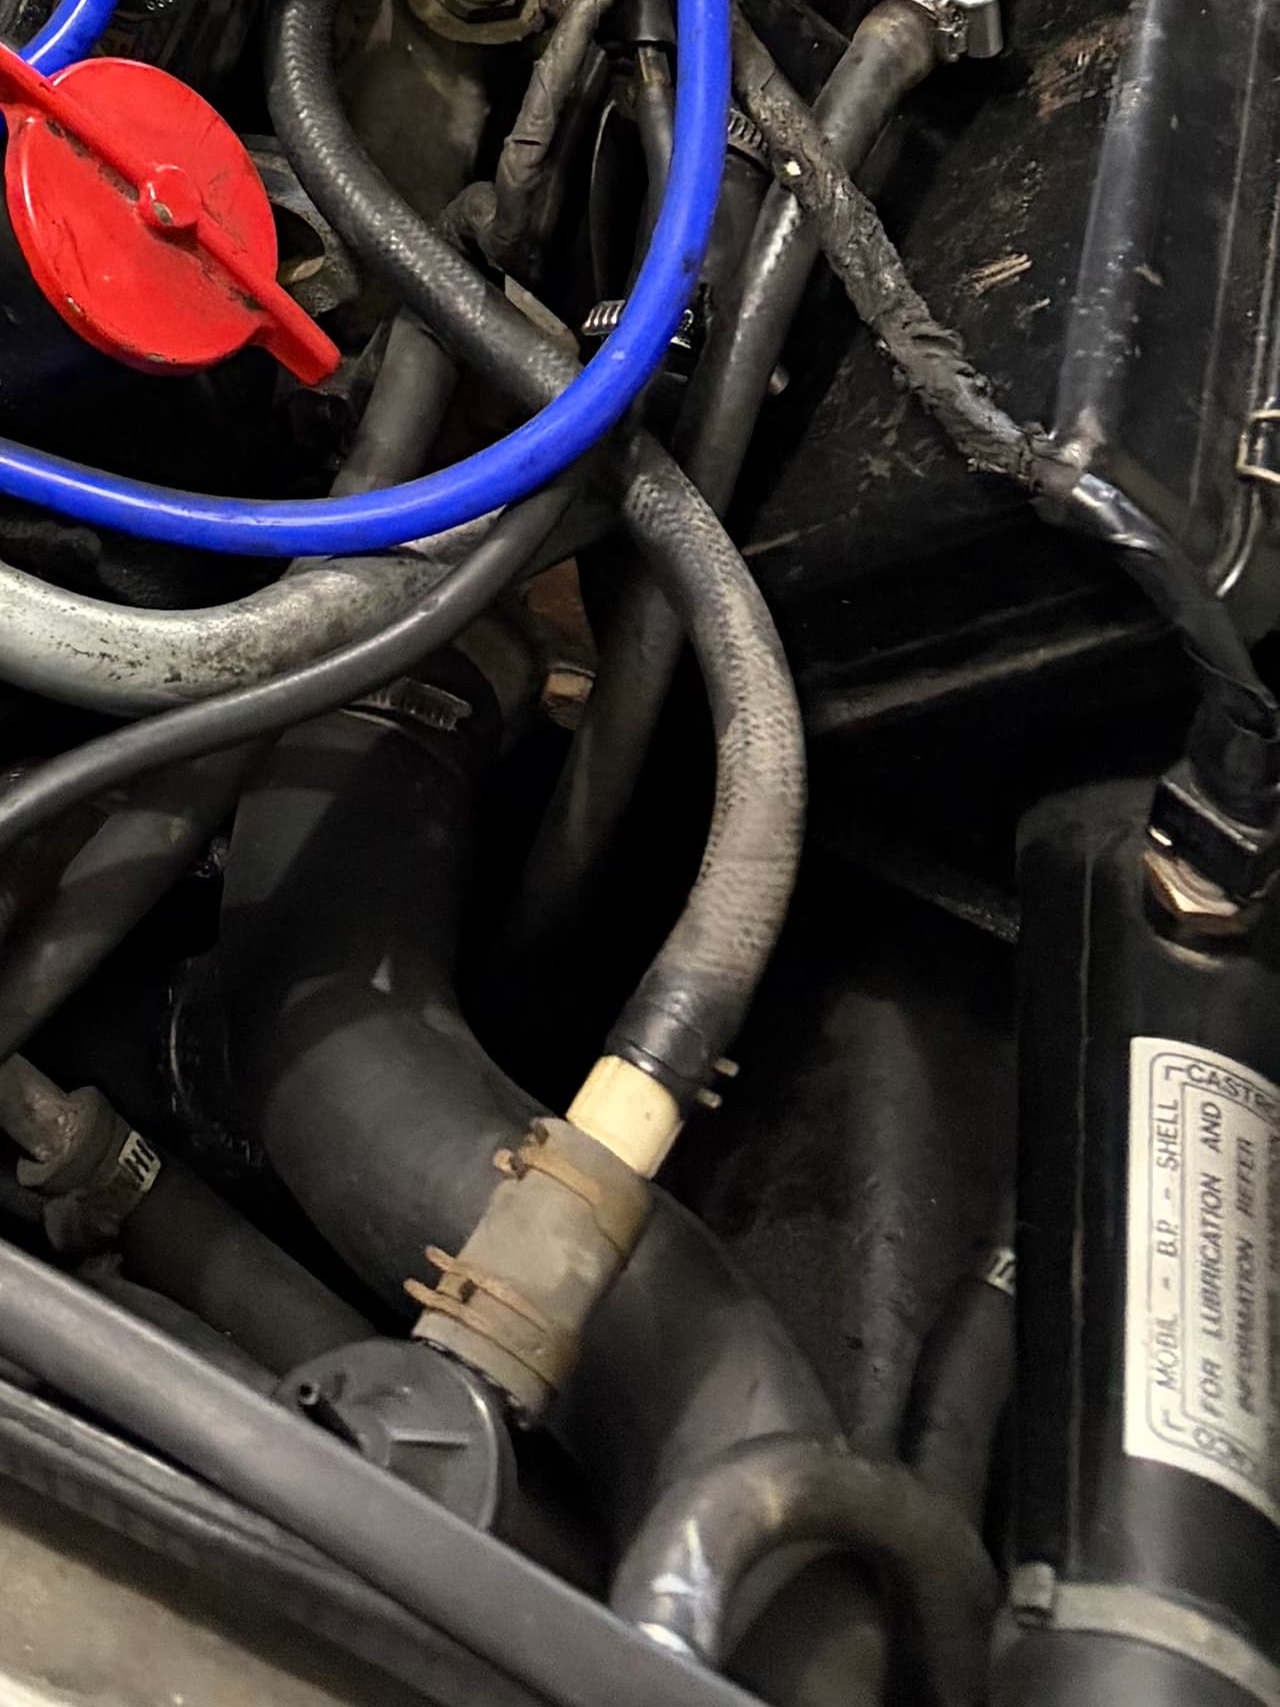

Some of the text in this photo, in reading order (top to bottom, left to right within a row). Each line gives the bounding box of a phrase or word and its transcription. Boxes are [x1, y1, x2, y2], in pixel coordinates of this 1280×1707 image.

[1156, 1098, 1180, 1173] SHELL
[1198, 1100, 1225, 1419] FOR LUBRICATION AND
[1236, 1136, 1258, 1415] INFORMATION REFER
[1155, 1311, 1179, 1391] MOBIL
